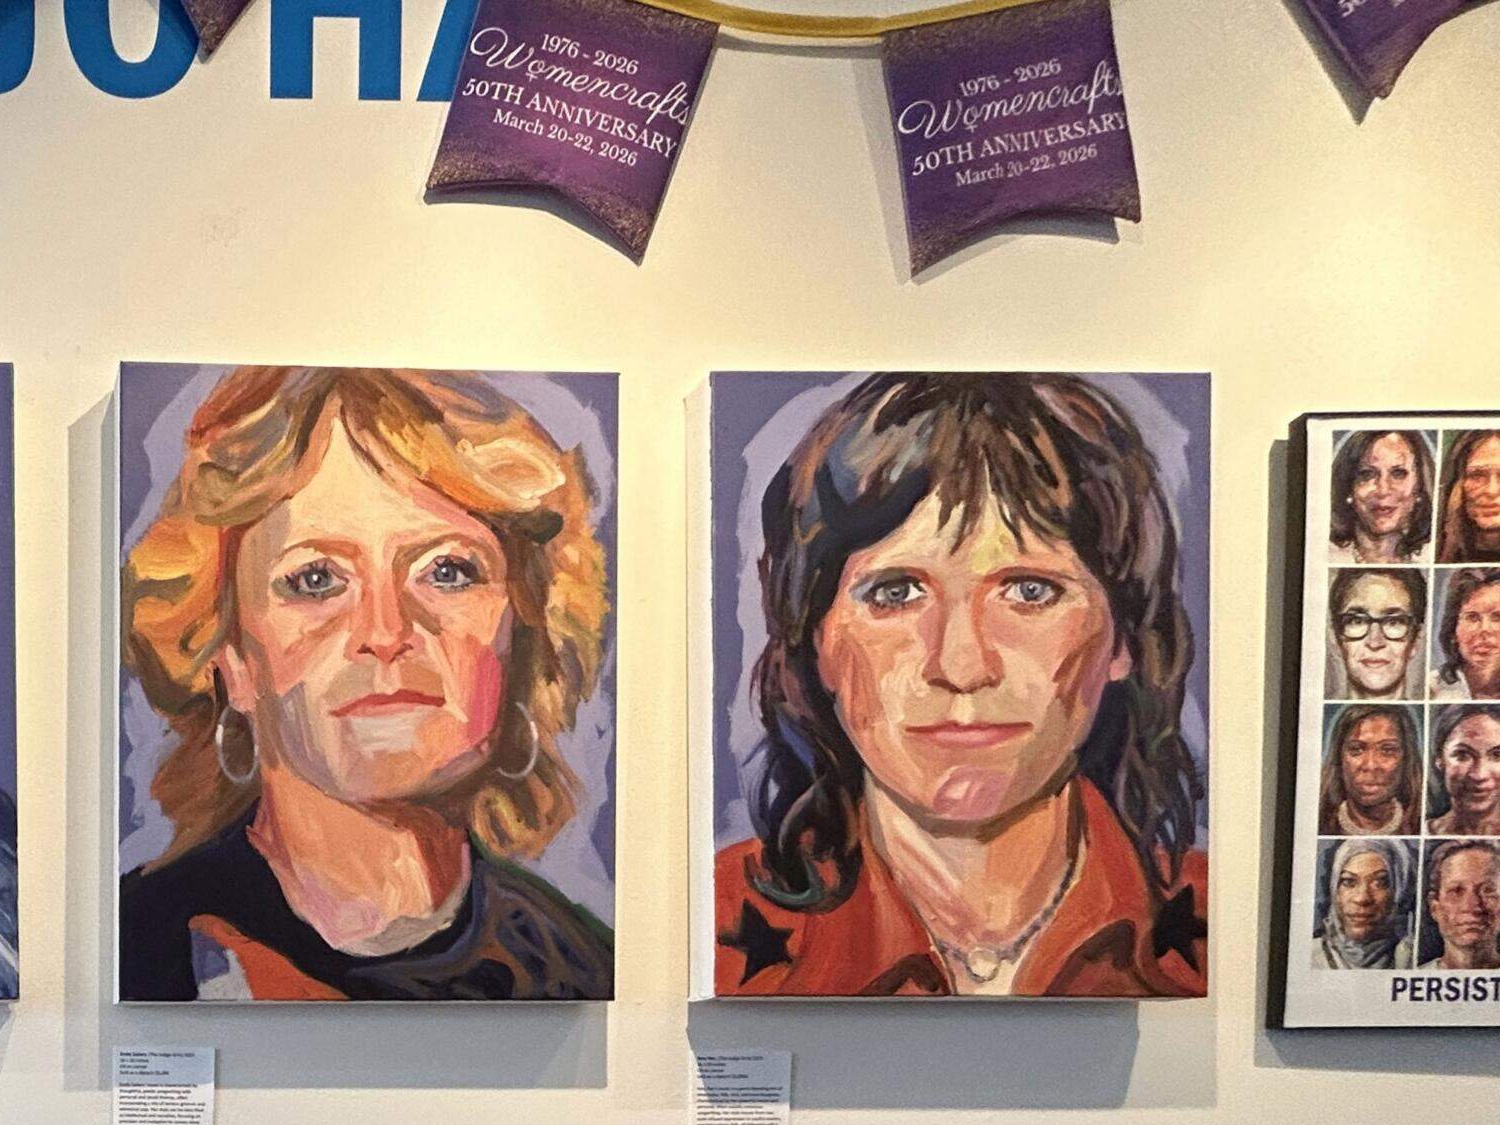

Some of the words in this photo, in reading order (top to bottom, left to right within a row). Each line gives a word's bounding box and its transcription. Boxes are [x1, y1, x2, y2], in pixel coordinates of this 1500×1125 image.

[469, 26, 690, 125] Womencrafts
[542, 34, 580, 58] 1976
[593, 50, 639, 75] 2026
[959, 75, 1000, 97] 1976
[1013, 58, 1062, 83] 2026
[462, 78, 525, 105] 50TH
[526, 93, 678, 158] ANNIVERSARY
[493, 108, 544, 135] March
[547, 124, 595, 154] 20-22,
[598, 142, 638, 166] 2026
[912, 143, 974, 176] 50TH
[980, 112, 1127, 158] ANNIVERSARY
[955, 160, 1003, 186] March
[1058, 144, 1098, 166] 2026
